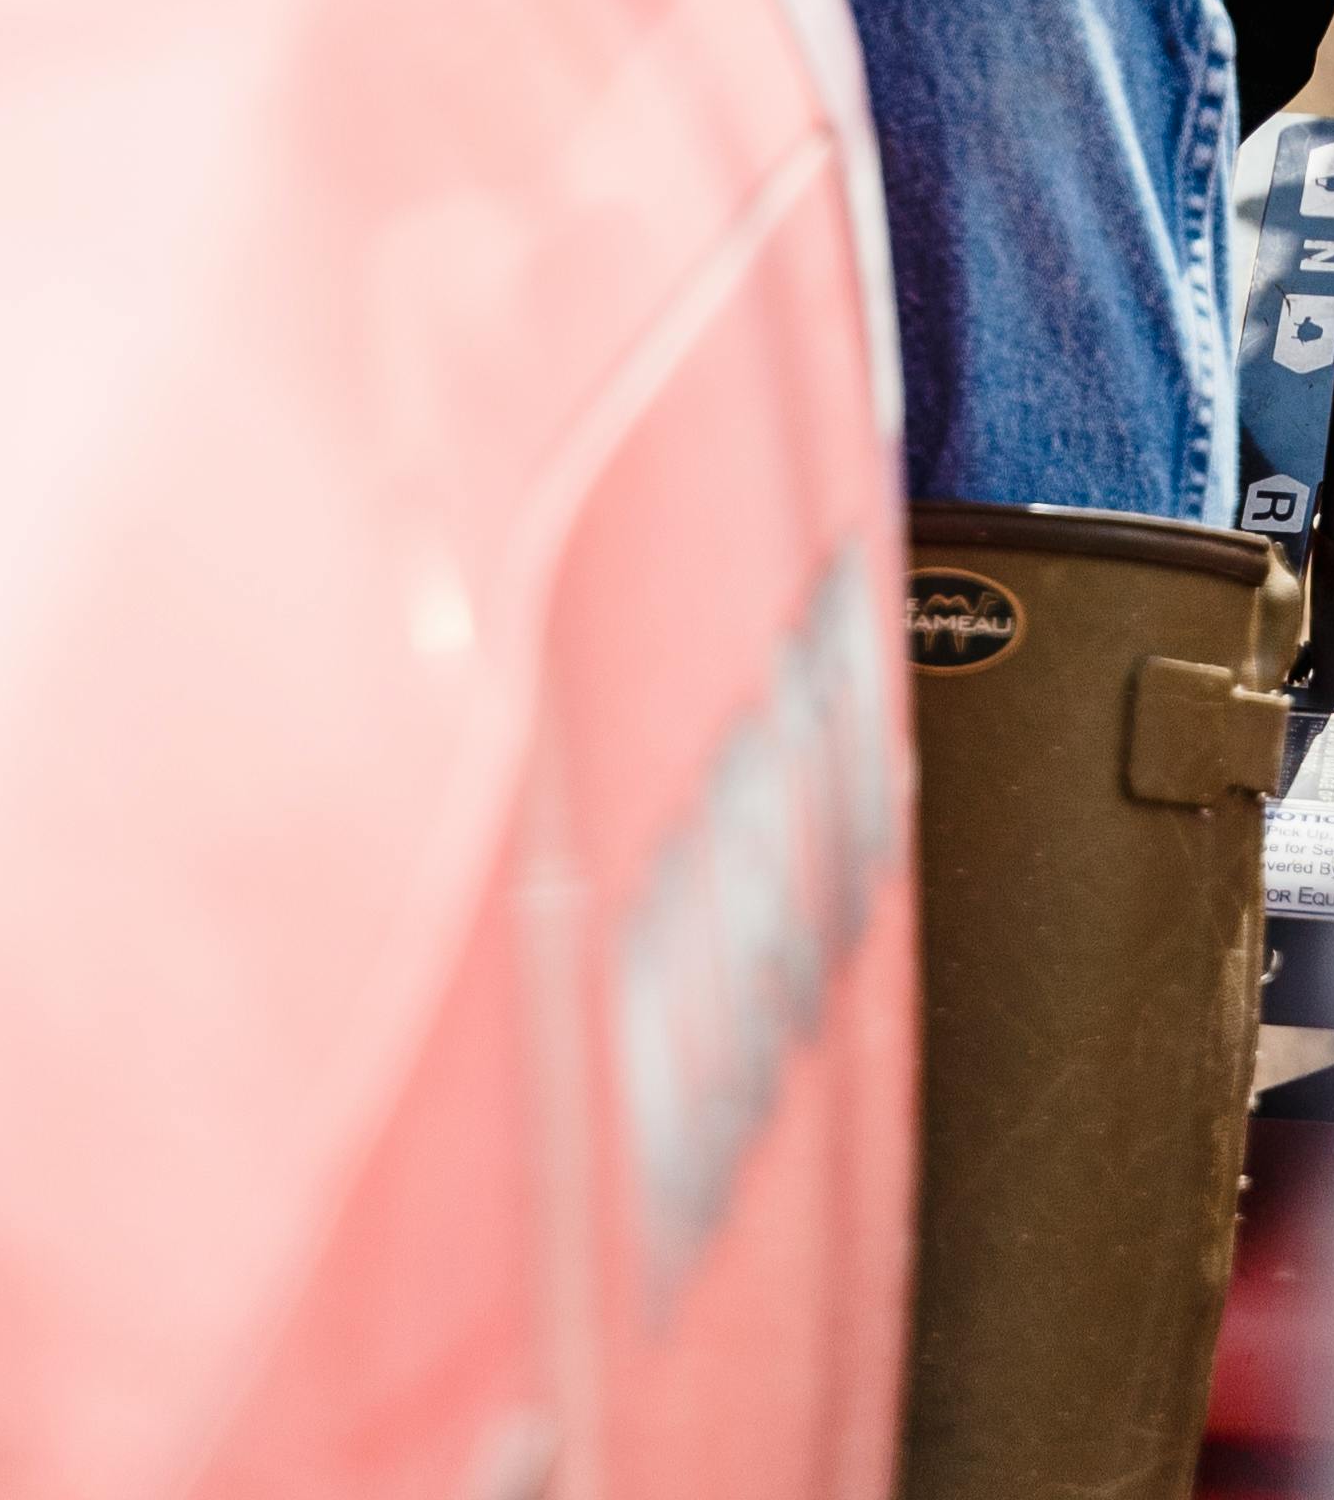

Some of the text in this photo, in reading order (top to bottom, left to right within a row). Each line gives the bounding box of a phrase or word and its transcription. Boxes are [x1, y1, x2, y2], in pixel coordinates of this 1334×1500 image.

[1251, 489, 1298, 523] R
[900, 613, 1013, 634] HAMEAU
[1266, 824, 1300, 838] Pick
[1284, 843, 1308, 856] for
[1263, 859, 1313, 875] vered
[1264, 887, 1292, 904] OR
